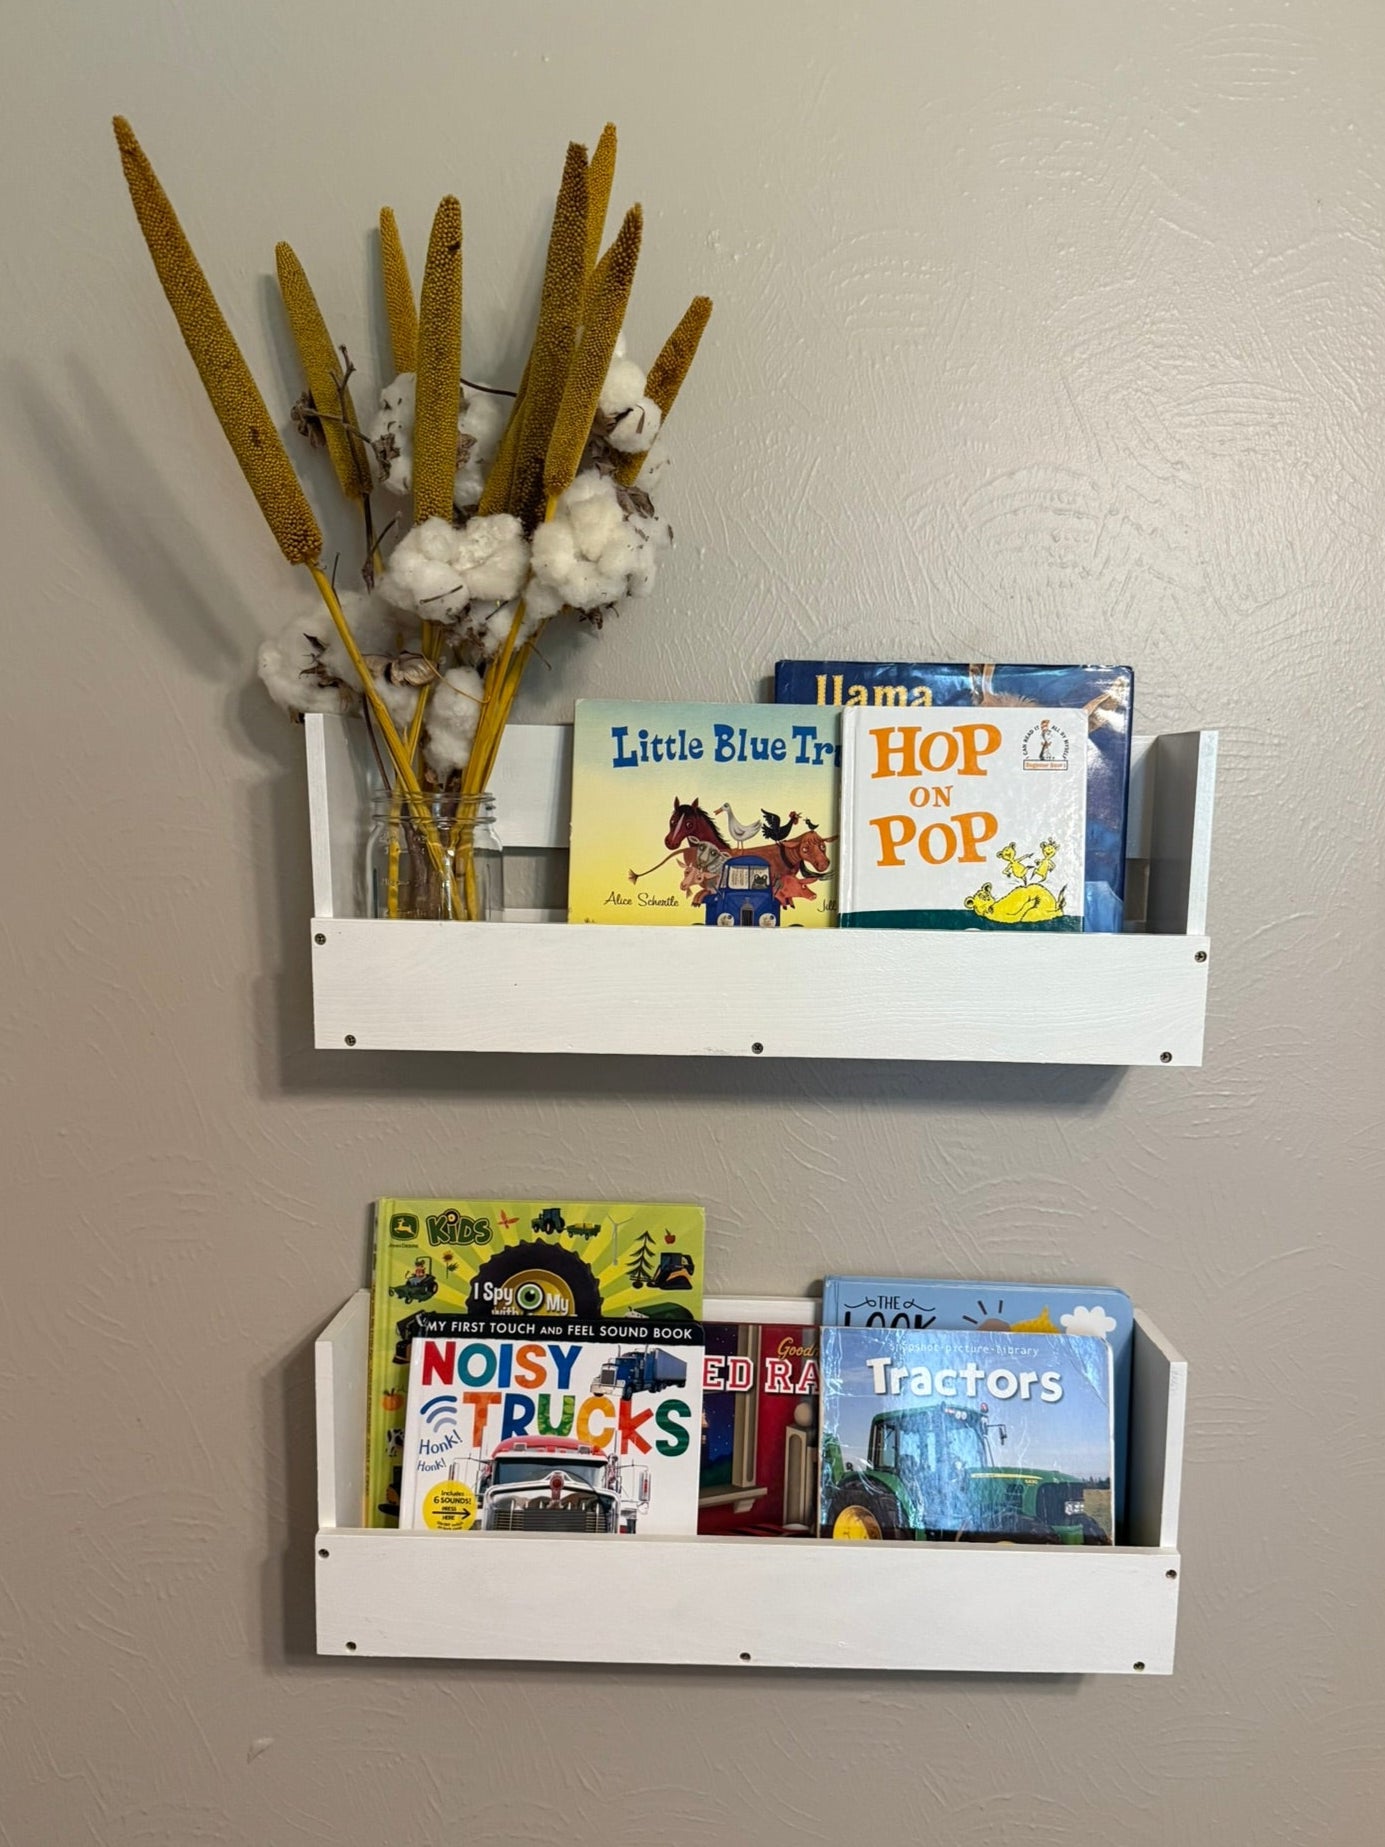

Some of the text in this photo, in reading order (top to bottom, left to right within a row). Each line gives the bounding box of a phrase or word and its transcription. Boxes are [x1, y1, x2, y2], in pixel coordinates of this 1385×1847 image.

[815, 674, 933, 706] llama
[611, 723, 841, 768] Little Blue Tr
[868, 723, 1003, 779] HOP
[908, 785, 954, 808] ON
[868, 811, 999, 867] POP
[603, 891, 680, 907] Alice Schertle
[473, 1281, 569, 1317] I Spy My
[876, 1295, 901, 1310] THE
[426, 1320, 693, 1340] MY FIRST TOUCH AND FEEL SOUND BOOK
[777, 1336, 820, 1360] Good
[421, 1340, 584, 1390] NOISY
[702, 1354, 819, 1394] ED RA
[866, 1356, 1064, 1403] Tractors
[462, 1391, 693, 1457] TRUCKS
[418, 1429, 463, 1456] Honk!
[416, 1457, 447, 1472] Honk!
[433, 1496, 472, 1505] 6 SOUNDS!
